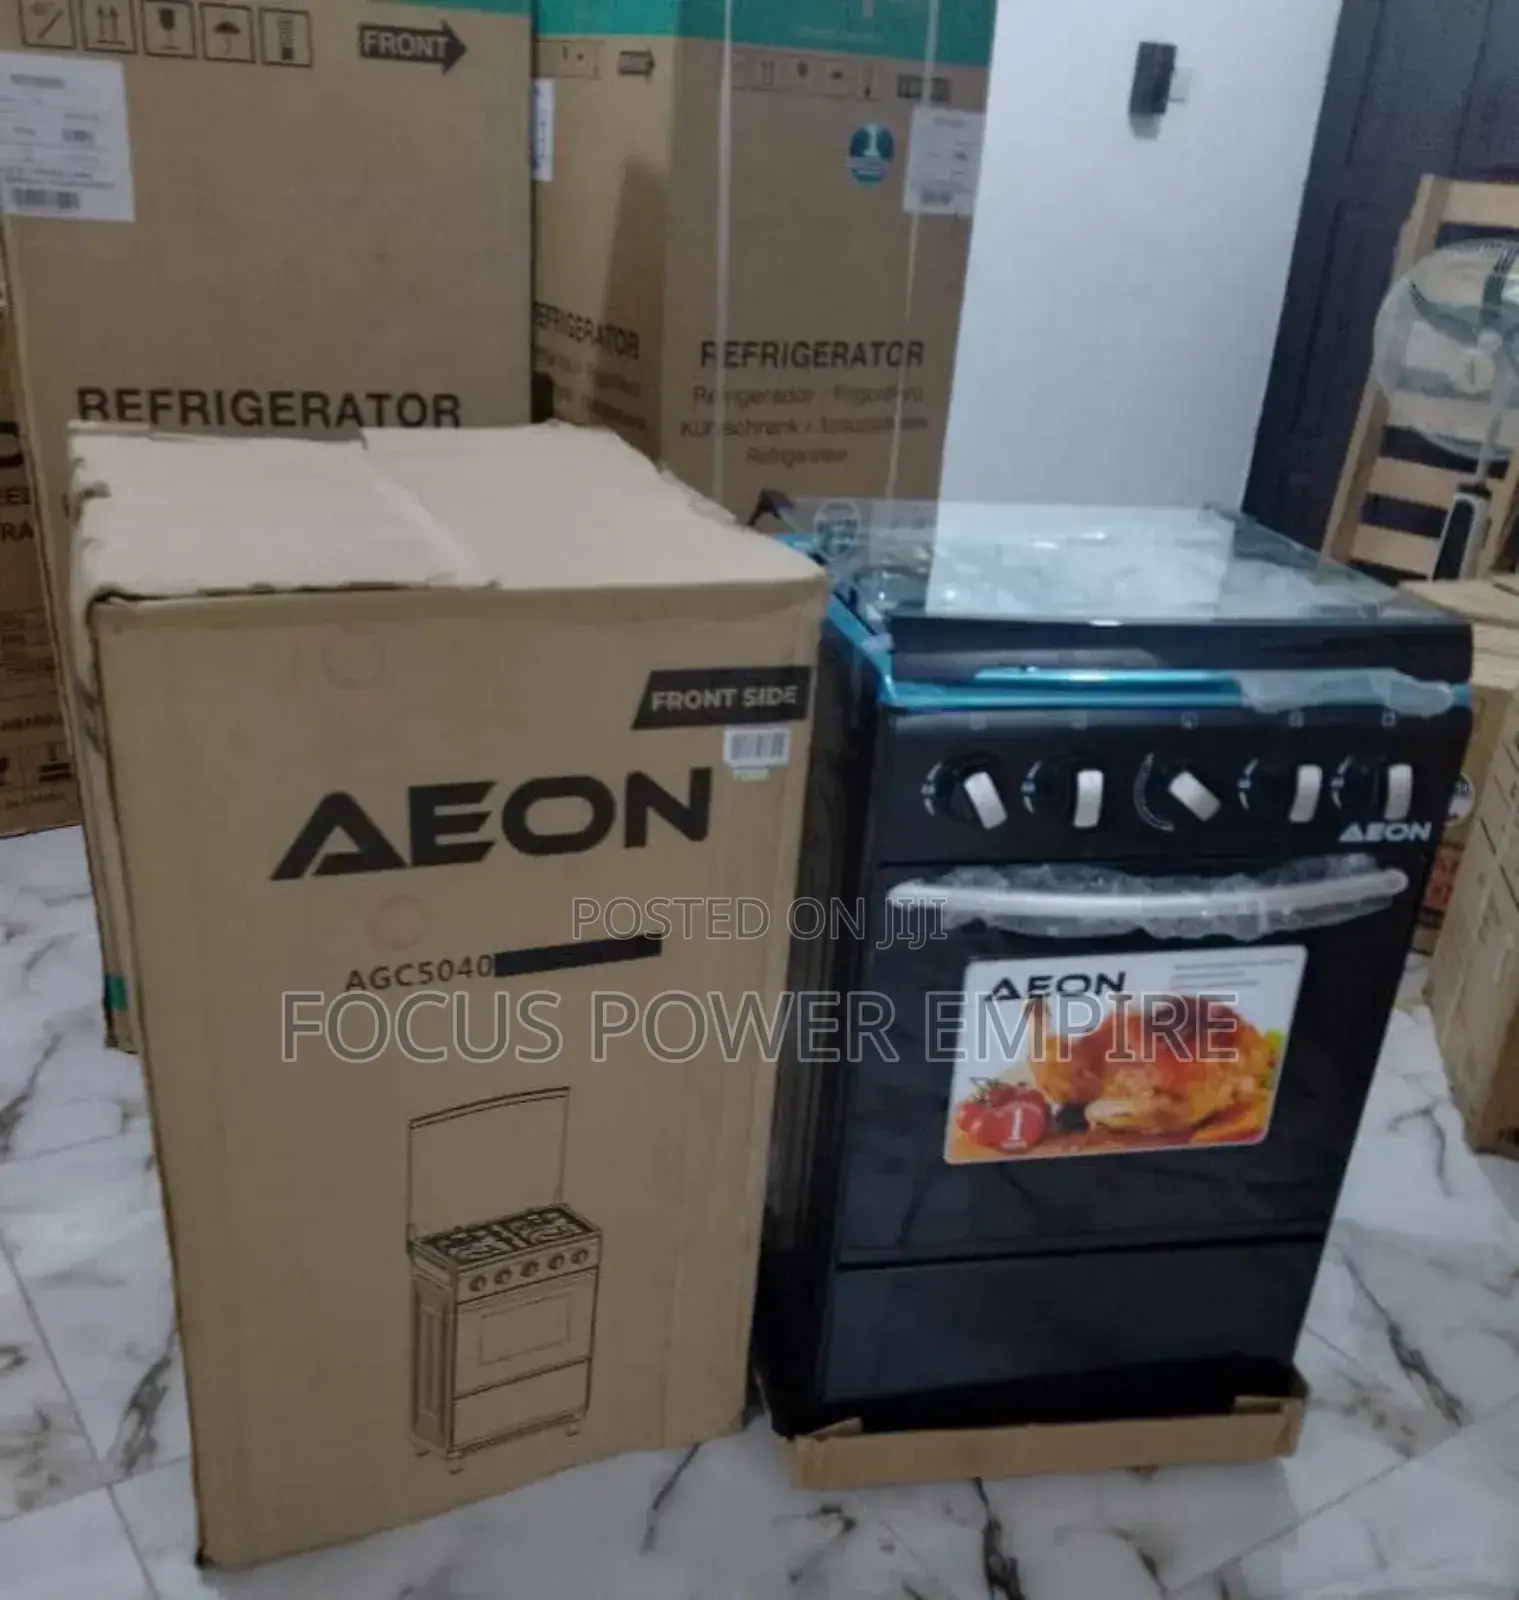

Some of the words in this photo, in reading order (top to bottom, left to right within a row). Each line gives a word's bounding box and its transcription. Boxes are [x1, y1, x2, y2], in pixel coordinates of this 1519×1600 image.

[362, 33, 450, 58] FRONT
[700, 340, 924, 369] REFRIGERATOR
[77, 386, 461, 428] REFRIGERATOR
[651, 687, 736, 712] FRONT
[744, 685, 799, 709] SIDE
[269, 766, 714, 881] AEON
[1338, 821, 1432, 844] AEON
[344, 953, 494, 992] AGC5040
[983, 971, 1128, 1002] AEON
